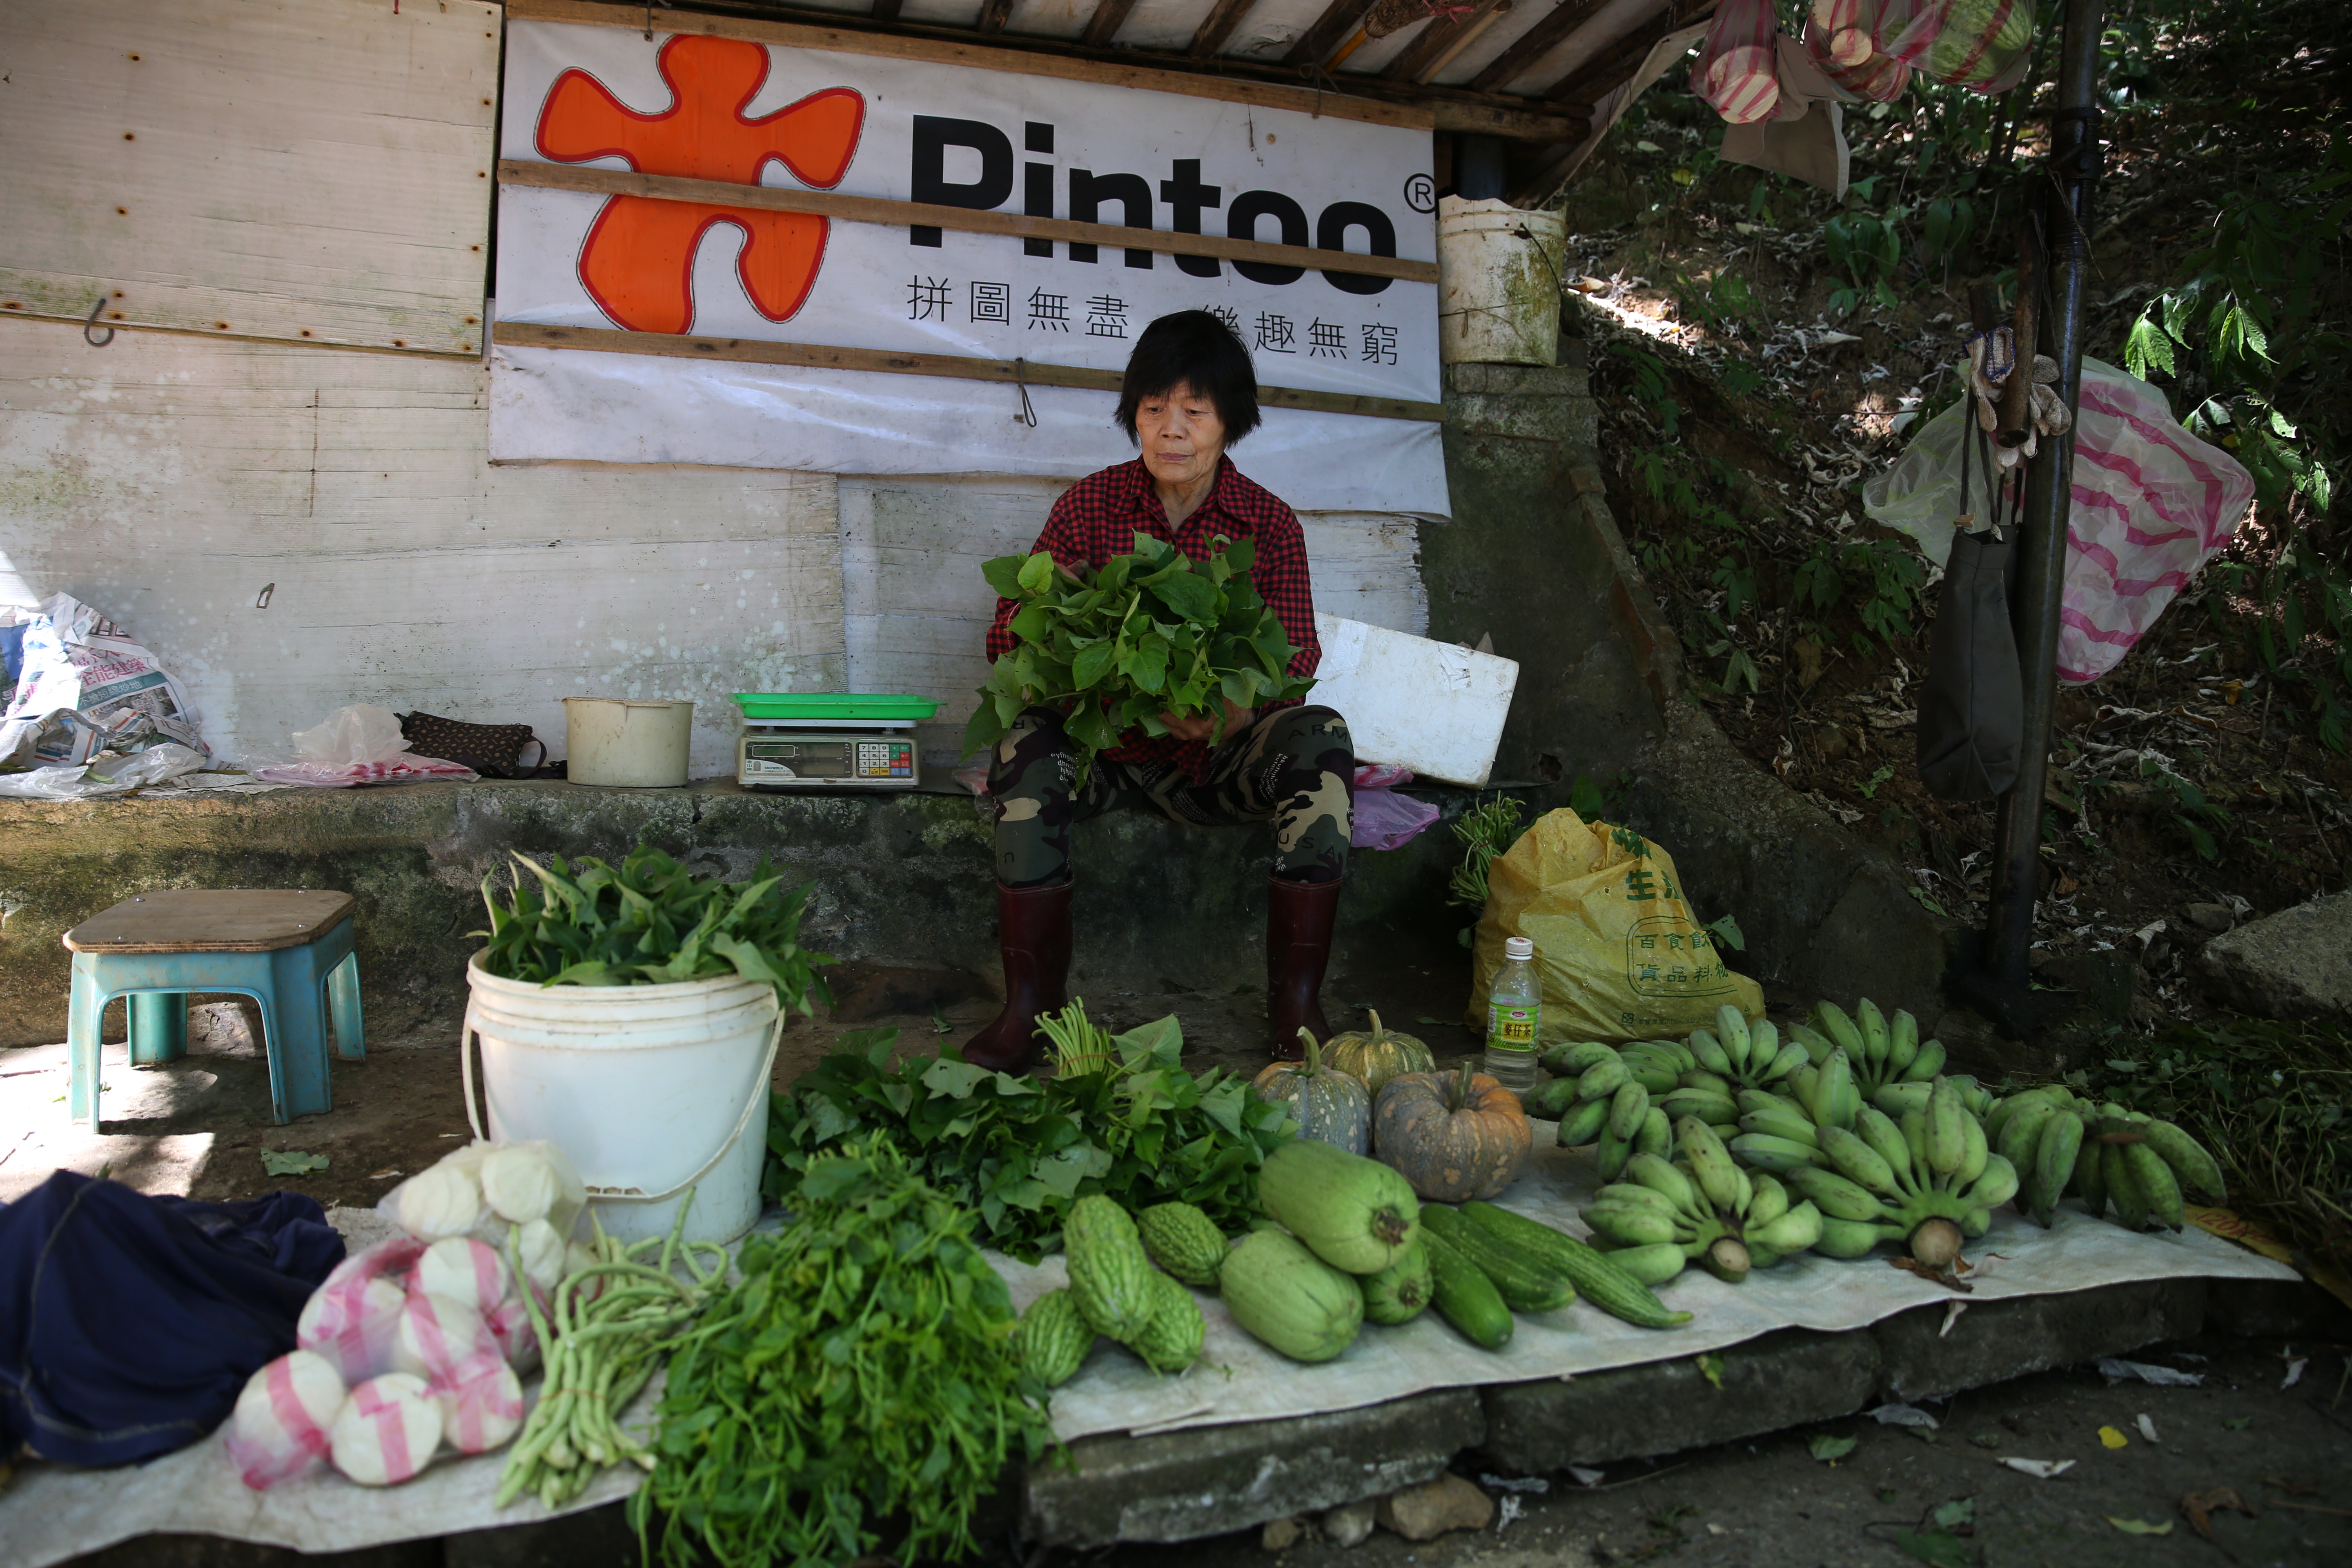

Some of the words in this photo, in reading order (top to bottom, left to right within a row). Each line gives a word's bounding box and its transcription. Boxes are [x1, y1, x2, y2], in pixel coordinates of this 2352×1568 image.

[910, 114, 1396, 295] Pintoo
[907, 275, 1129, 339] 拼圖無盡
[1504, 1023, 1530, 1037] 麥仔茶
